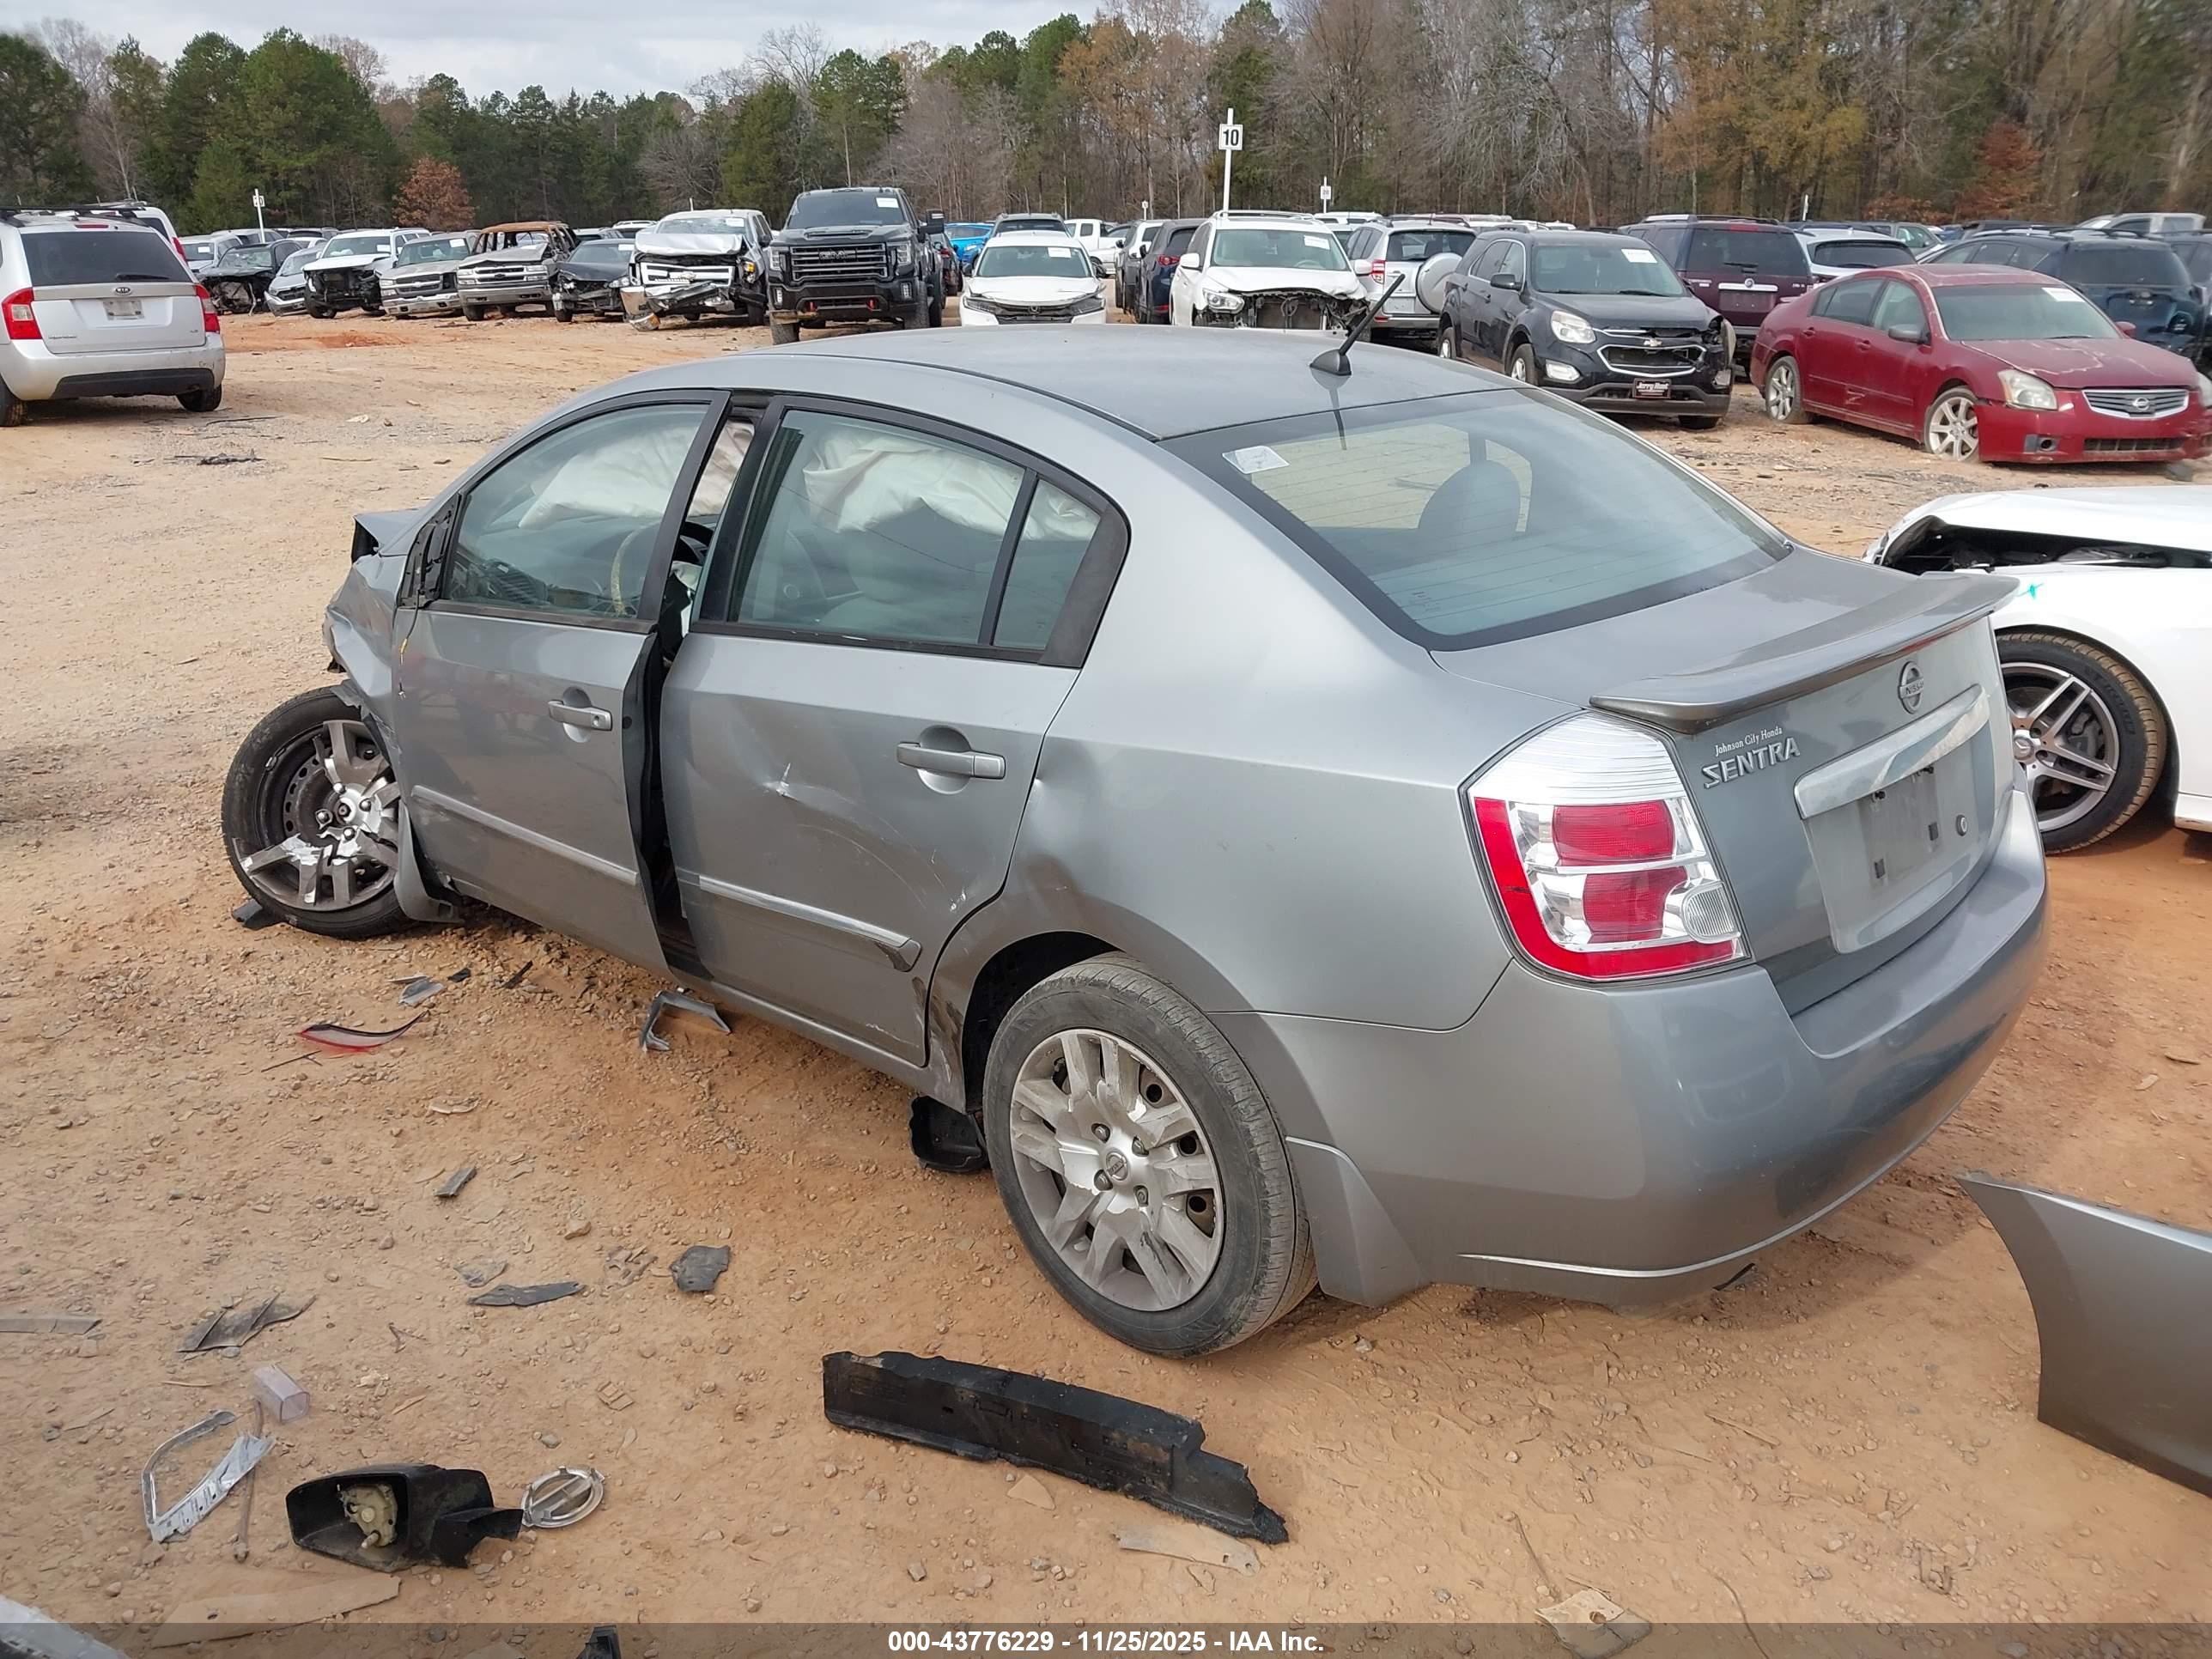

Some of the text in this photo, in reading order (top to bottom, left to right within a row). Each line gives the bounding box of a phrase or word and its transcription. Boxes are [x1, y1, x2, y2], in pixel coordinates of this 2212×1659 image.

[1223, 129, 1239, 146] 10
[1715, 726, 1783, 757] Johnson City Honda
[1702, 737, 1801, 789] SENTRA
